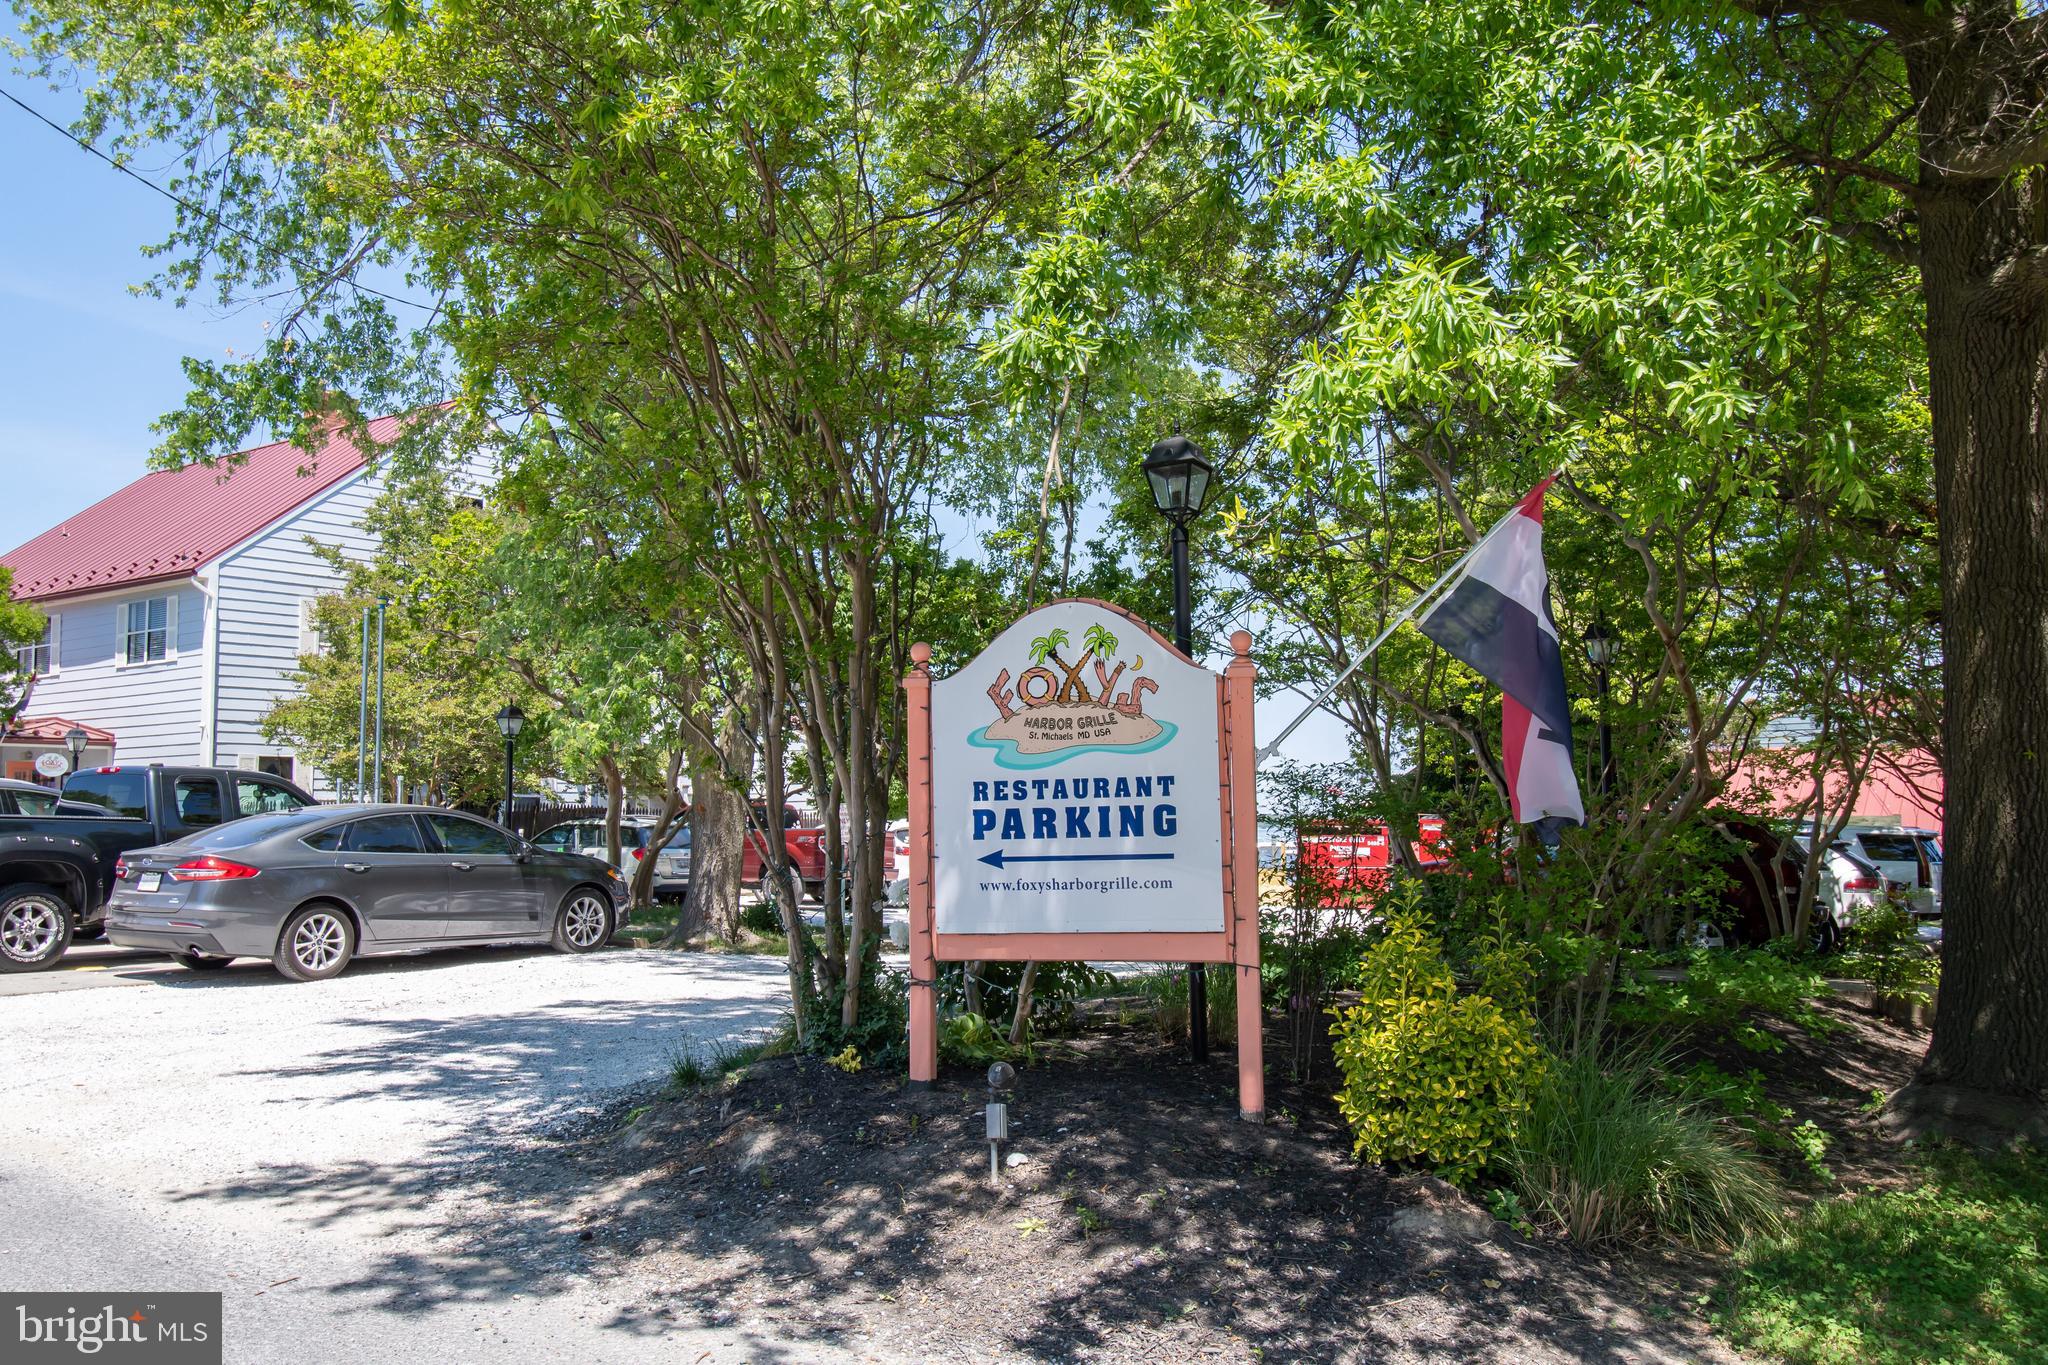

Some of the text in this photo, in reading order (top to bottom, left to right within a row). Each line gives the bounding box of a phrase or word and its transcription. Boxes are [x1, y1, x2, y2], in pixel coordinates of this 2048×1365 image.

[1023, 712, 1118, 731] HARBOR GRILLE
[1028, 728, 1111, 741] St. Michaels MD USA
[973, 775, 1175, 801] RESTAURANT
[973, 804, 1177, 840] PARKING
[979, 877, 1173, 894] www.foxysharborgrille.com
